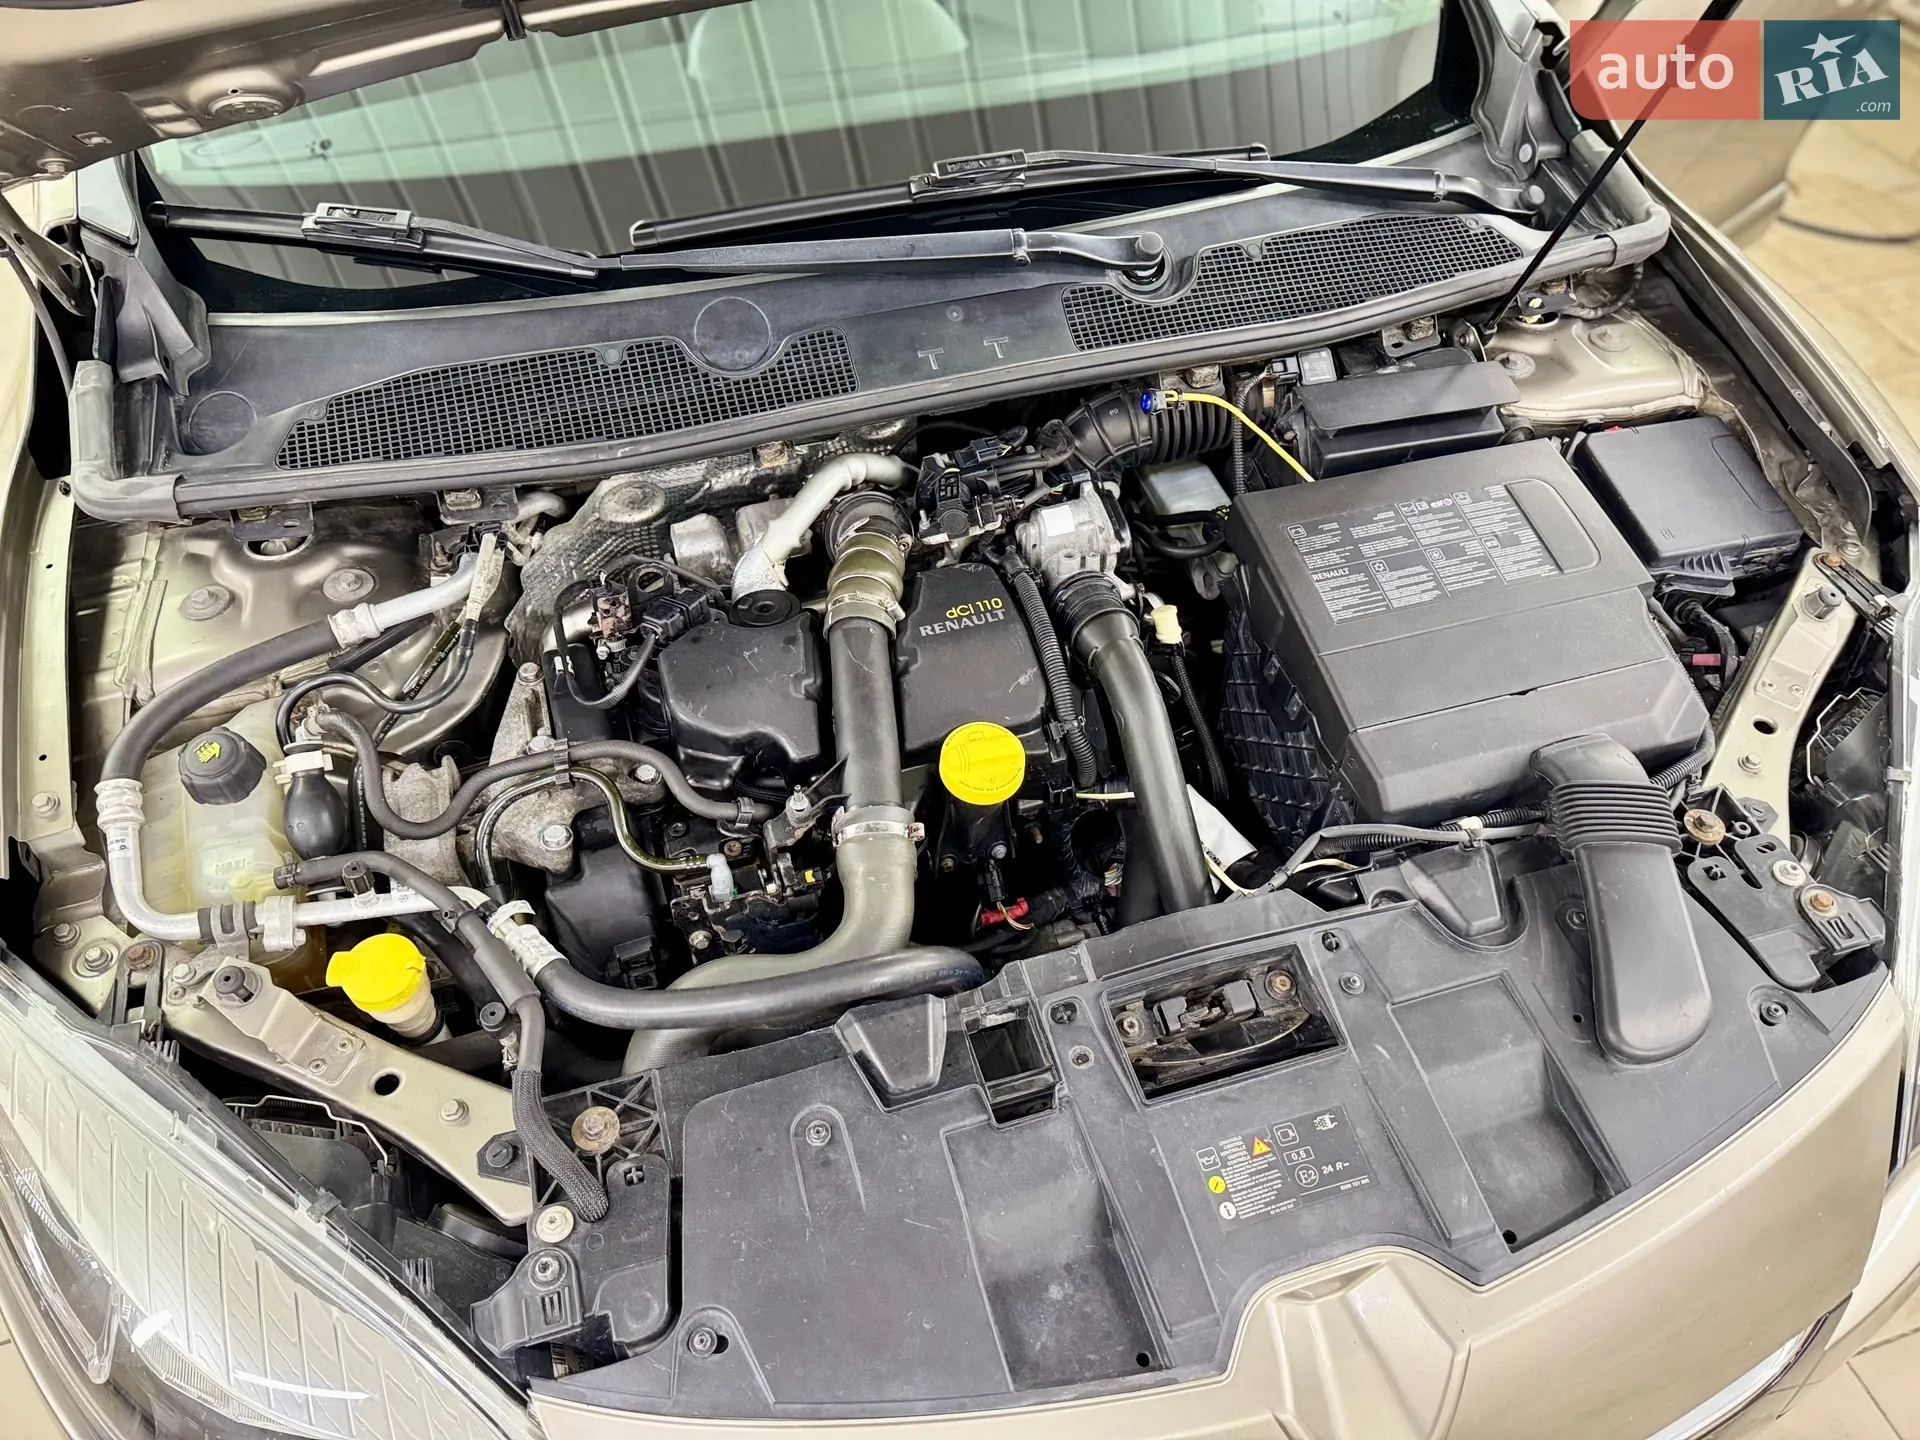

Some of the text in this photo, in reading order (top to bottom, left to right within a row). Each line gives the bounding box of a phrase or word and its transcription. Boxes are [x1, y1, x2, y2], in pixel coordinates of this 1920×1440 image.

[1311, 567, 1349, 581] RENAULT
[976, 597, 1003, 612] 110
[919, 608, 1005, 637] RENAULT
[1291, 1150, 1306, 1160] 0,5
[1298, 1169, 1317, 1184] E2
[1321, 1164, 1334, 1175] 24
